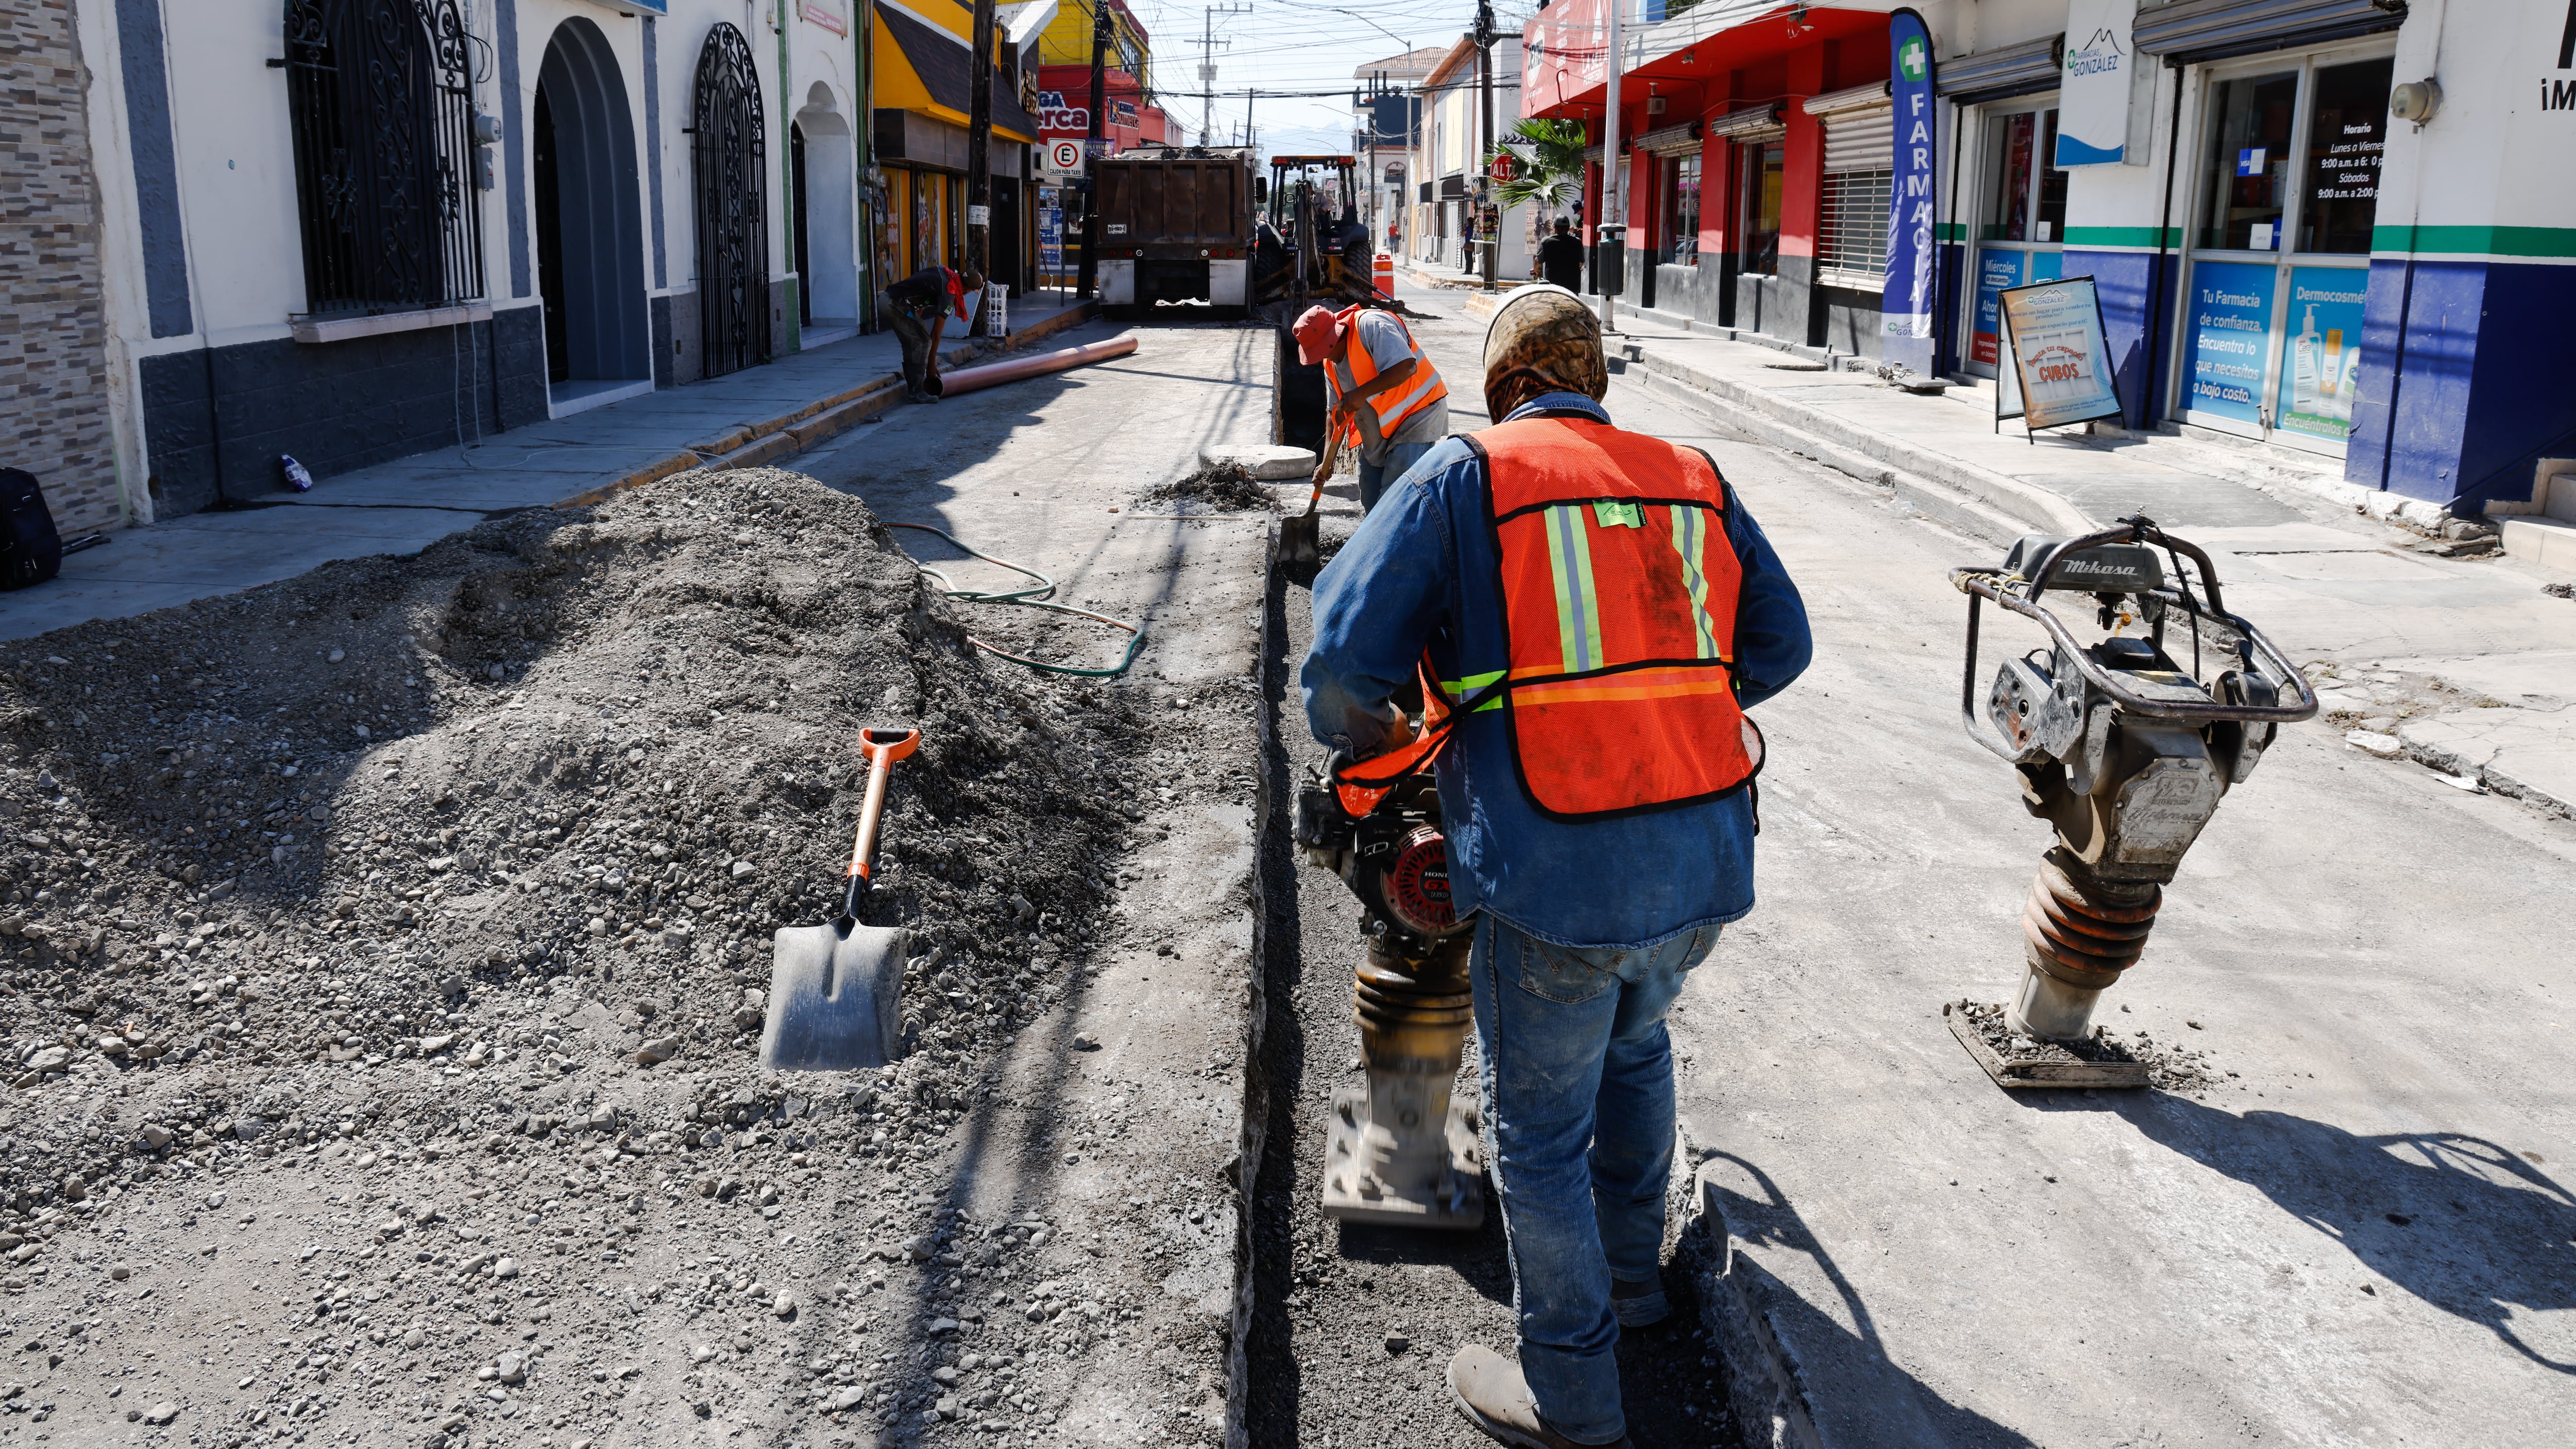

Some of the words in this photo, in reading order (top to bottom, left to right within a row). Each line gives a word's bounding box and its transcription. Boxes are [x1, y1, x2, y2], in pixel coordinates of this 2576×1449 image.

[2076, 48, 2099, 59] FARMACIAS
[1582, 53, 1590, 74] LA
[2074, 54, 2118, 77] GONZÁLEZ
[1039, 92, 1064, 108] GA
[1039, 109, 1088, 128] erca
[2344, 123, 2371, 134] Horario
[1061, 148, 1071, 162] E
[2330, 144, 2351, 154] Lunes
[2359, 141, 2385, 151] Viernes
[2321, 158, 2337, 169] 9:00
[2338, 159, 2353, 167] a.m.
[2338, 173, 2369, 183] Sábados
[1907, 93, 1930, 302] FARMACIA
[2318, 189, 2334, 198] 9:00
[2334, 189, 2349, 198] a.m.
[2356, 187, 2374, 197] 2:00
[1985, 259, 2016, 274] Miércoles
[1981, 299, 1997, 313] Ahor
[2033, 296, 2064, 306] GONZÁLEZ
[2202, 289, 2213, 303] Tu
[2215, 290, 2261, 308] Farmacia
[1985, 313, 1996, 321] hasta
[2035, 312, 2063, 320] producto?
[2200, 312, 2211, 327] de
[2213, 315, 2263, 333] confianza.
[2047, 321, 2067, 329] espacio
[1978, 338, 1997, 348] Impresione
[2197, 334, 2244, 353] Encuentra
[2246, 340, 2256, 355] lo
[2298, 342, 2318, 353] Cerae
[2056, 345, 2084, 361] espacio
[2039, 363, 2079, 382] CUBOS
[2195, 359, 2211, 374] que
[2213, 362, 2259, 381] necesitas
[2193, 382, 2198, 394] a
[2200, 381, 2221, 401] bajo
[2222, 388, 2251, 403] costo.
[2282, 413, 2342, 436] Encuéntralos
[2062, 559, 2138, 575] Mikasa
